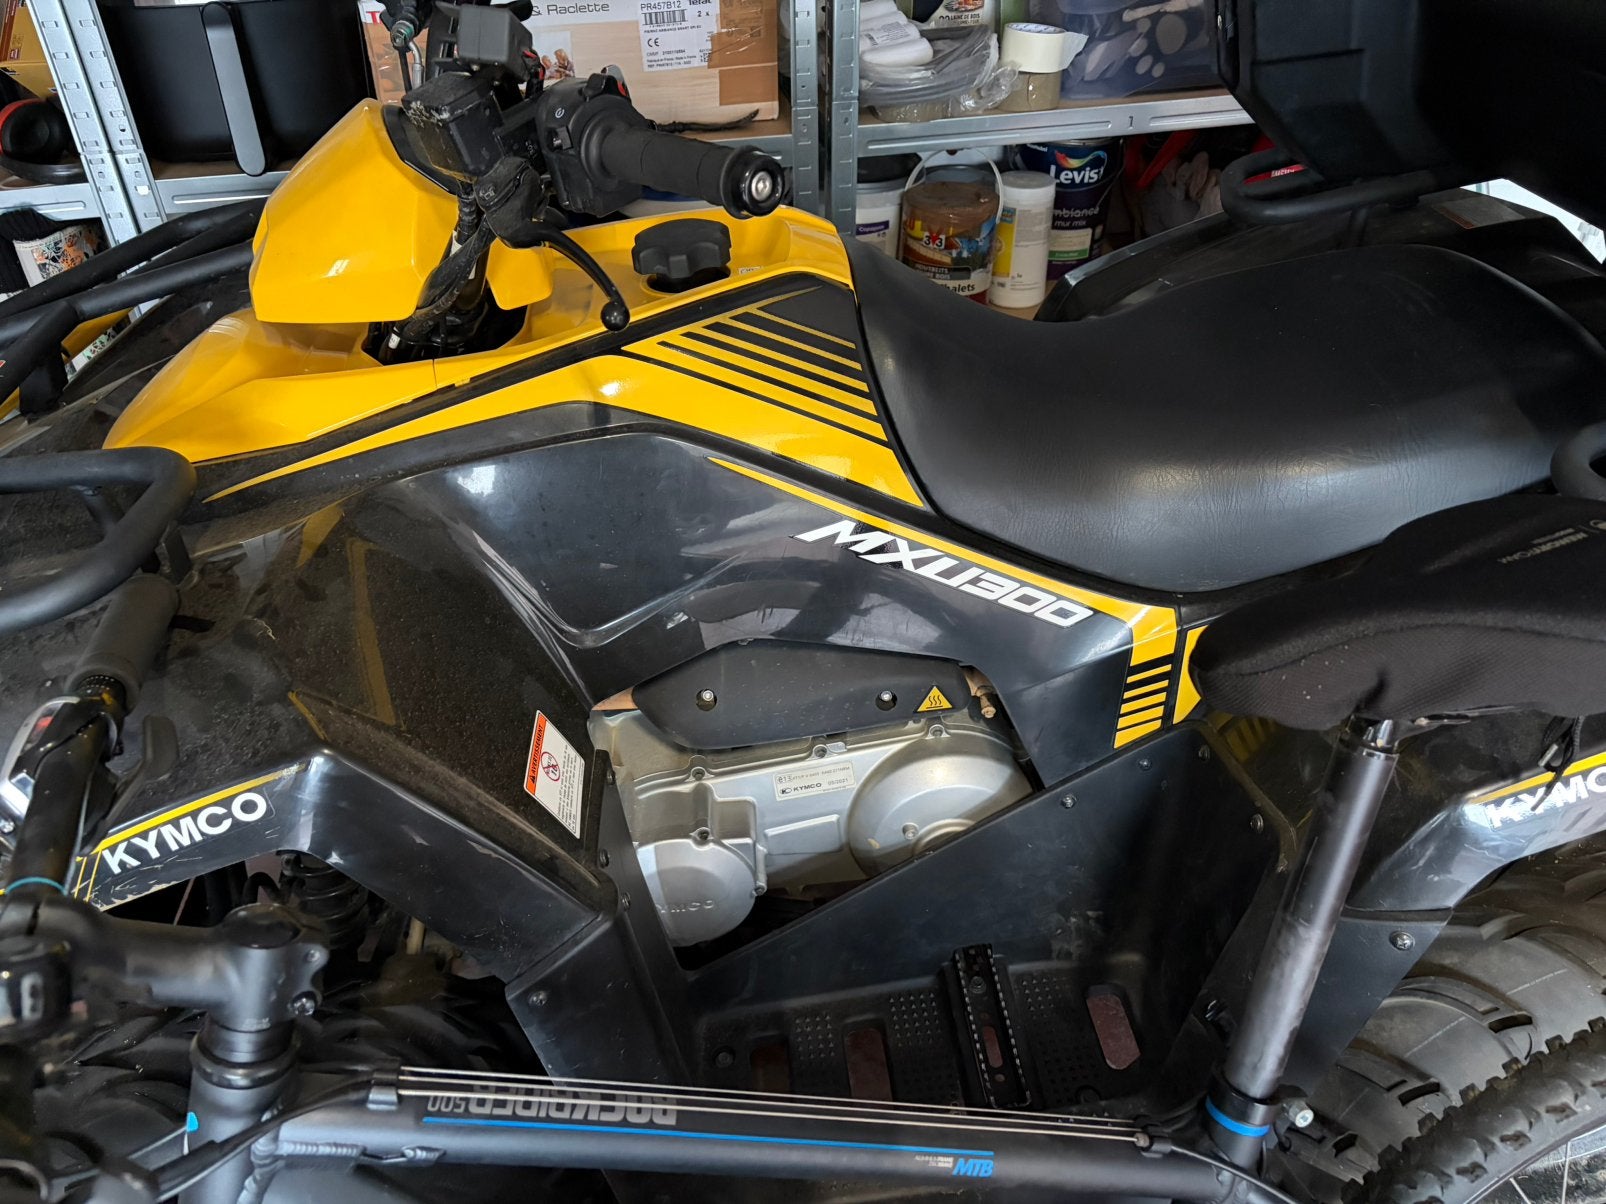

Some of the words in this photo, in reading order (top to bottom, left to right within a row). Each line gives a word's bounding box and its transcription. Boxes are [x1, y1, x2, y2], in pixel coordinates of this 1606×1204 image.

[546, 3, 610, 16] Raclette
[640, 1, 682, 11] PR457B12
[1050, 164, 1098, 184] Levis
[793, 519, 1094, 628] MXU300
[531, 724, 544, 774] AVERTISSEMENT
[793, 782, 822, 792] KYMCO
[102, 792, 267, 875] KYMCO
[427, 1093, 466, 1113] 500
[468, 1084, 677, 1126] ROCKRIDER
[952, 1157, 994, 1178] MTB
